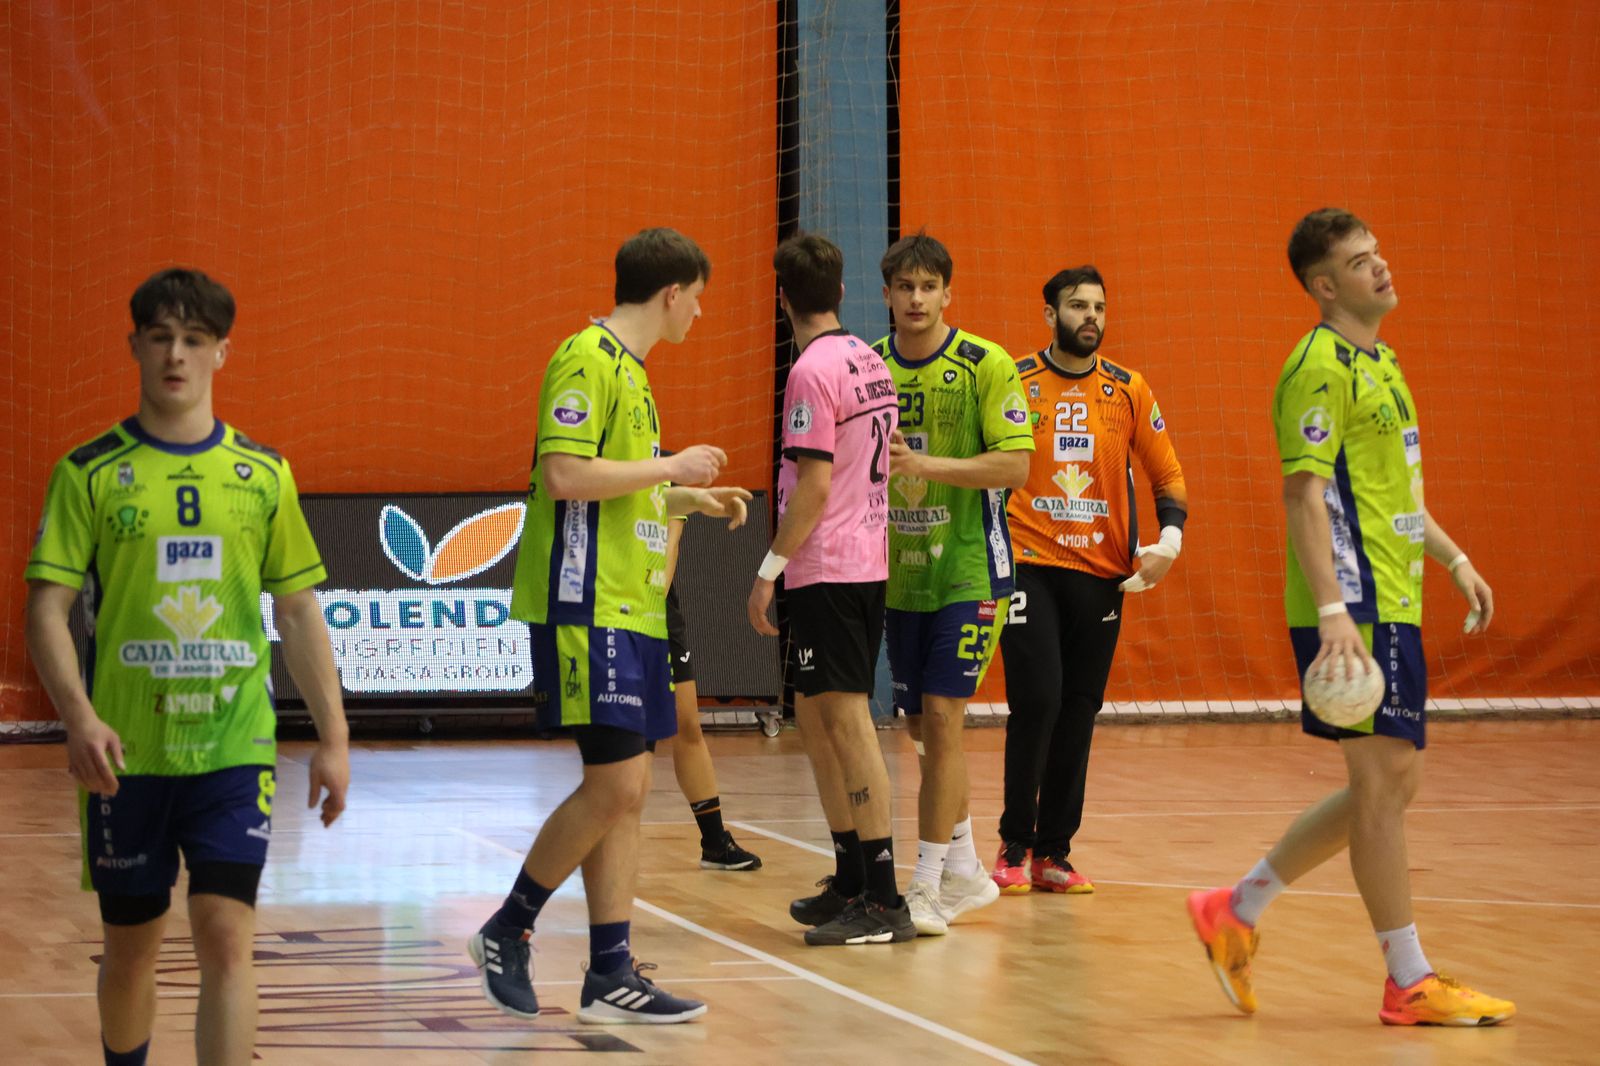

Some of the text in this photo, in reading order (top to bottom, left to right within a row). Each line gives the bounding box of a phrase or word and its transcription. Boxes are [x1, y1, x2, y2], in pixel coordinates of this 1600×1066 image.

[897, 391, 925, 427] 23
[1055, 401, 1088, 432] 22
[1059, 436, 1089, 450] gaza
[176, 485, 202, 527] 8
[888, 509, 907, 522] AJA
[1034, 498, 1108, 514] CAJA RURAL
[165, 540, 214, 564] gaza
[324, 600, 510, 629] OLEND
[1005, 591, 1027, 624] 2
[122, 643, 254, 663] CAJA RURAL
[334, 637, 531, 658] NGREDIEN
[957, 623, 993, 660] 23
[444, 665, 523, 680] GROUP
[257, 769, 276, 816] 8
